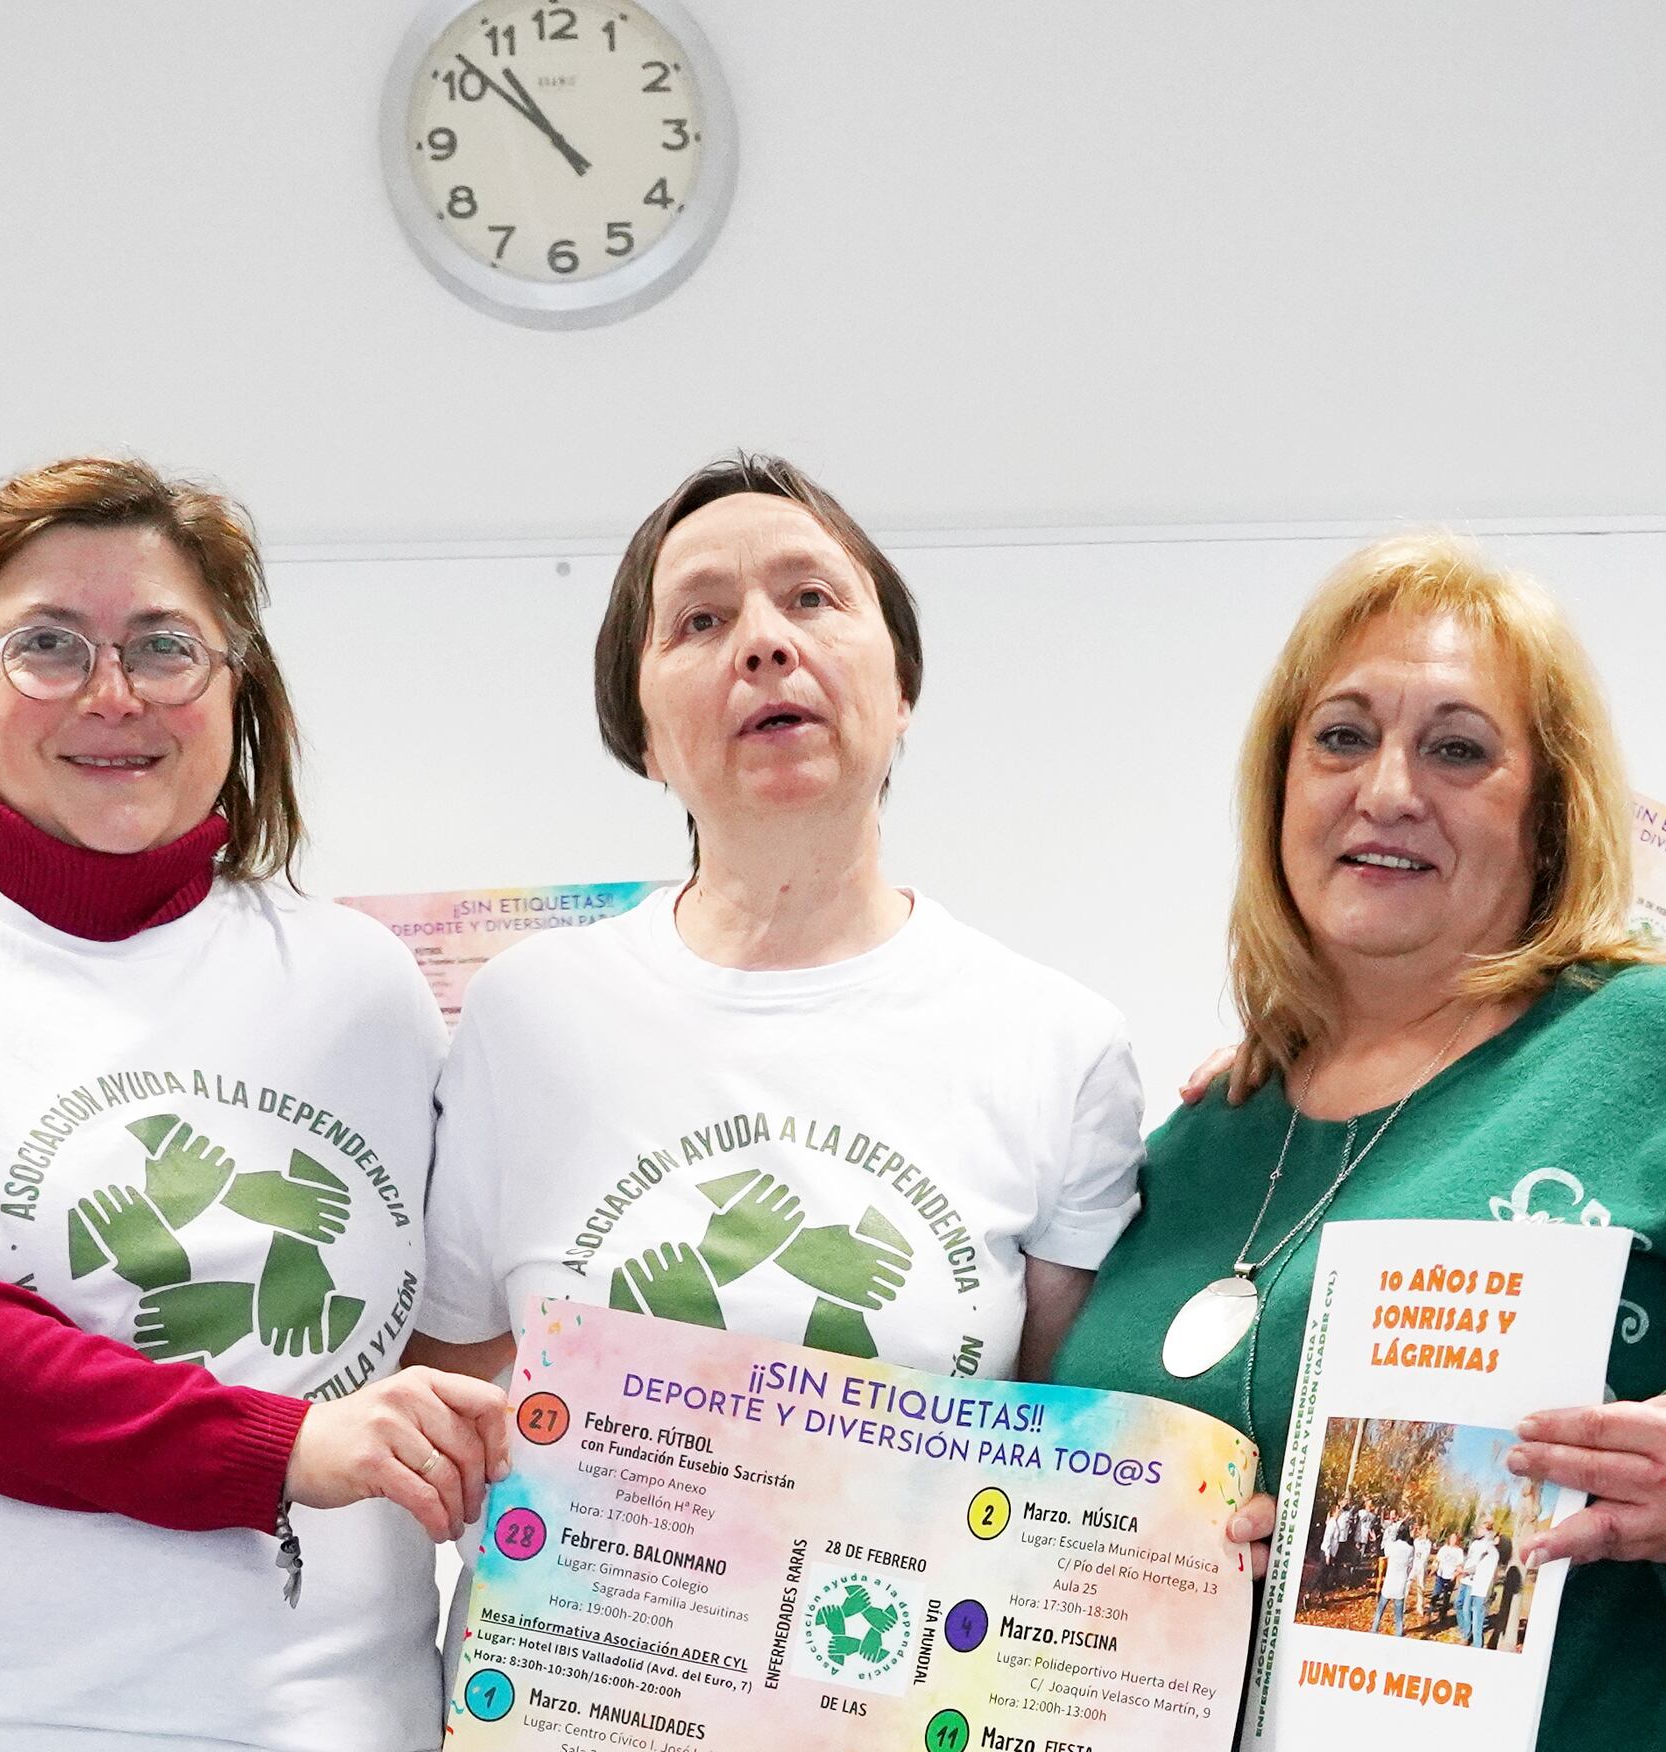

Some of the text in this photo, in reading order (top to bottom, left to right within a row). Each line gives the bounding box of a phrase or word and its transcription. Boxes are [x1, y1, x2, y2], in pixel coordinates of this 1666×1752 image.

[485, 25, 515, 56] 11
[532, 8, 578, 41] 12
[602, 20, 616, 51] 1
[442, 69, 488, 101] 10
[642, 62, 671, 92] 2
[428, 127, 457, 161] 9
[662, 118, 690, 151] 3
[447, 185, 478, 219] 8
[643, 176, 675, 210] 4
[488, 225, 516, 259] 7
[605, 222, 634, 256] 5
[547, 239, 579, 274] 6
[391, 921, 464, 938] DEPORTE
[468, 920, 481, 935] Y
[1, 1069, 411, 1229] ASOCIACIÓN AYUDA A LA DEPENDENCIA
[561, 1111, 981, 1295] ASOCIACIÓN AYUDA A LA DEPENDENCIA
[1380, 1263, 1524, 1297] 10 AÑOS DE
[369, 1330, 386, 1357] Y
[383, 1269, 418, 1341] LEÓN
[1372, 1304, 1517, 1335] SONRISAS Y
[1371, 1337, 1500, 1374] LÁGRIMAS
[748, 1361, 1046, 1434] ¡¡SIN ETIQUETAS!!
[528, 1408, 558, 1433] 27
[584, 1411, 714, 1454] Febrero. FÚTBOL
[623, 1373, 1163, 1487] DEPORTE Y DIVERSIÓN PARA TOD@S
[578, 1461, 707, 1496] Lugar: Campo Anexo
[580, 1439, 795, 1490] con Fundación Eusebio Sacristán
[569, 1501, 695, 1536] Hora: 17:00h-18:00h
[615, 1488, 716, 1521] Pabellón Hª Rey
[981, 1504, 995, 1526] 2
[1023, 1501, 1138, 1533] Marzo. MÚSICA
[504, 1523, 536, 1549] 28
[560, 1526, 727, 1576] Febrero. BALONMANO
[824, 1539, 927, 1573] 28 DE FEBRERO
[764, 1539, 808, 1690] ENFERMEDADES RARAS
[481, 1607, 748, 1674] Mesa informativa Asociación ADER CYL
[913, 1599, 943, 1686] DÍA MUNDIAL
[999, 1615, 1117, 1652] Marzo. PISCINA
[473, 1648, 682, 1699] Hora: 8:30h-10:30h/16:00h-20:00h
[477, 1628, 753, 1695] Lugar: Hotel IBIS Valladolid (Avd. del Euro, 7)
[1298, 1660, 1474, 1709] JUNTOS MEJOR
[529, 1687, 706, 1740] Marzo. MANUALIDADES
[820, 1694, 867, 1717] DE LAS
[936, 1725, 959, 1750] 11
